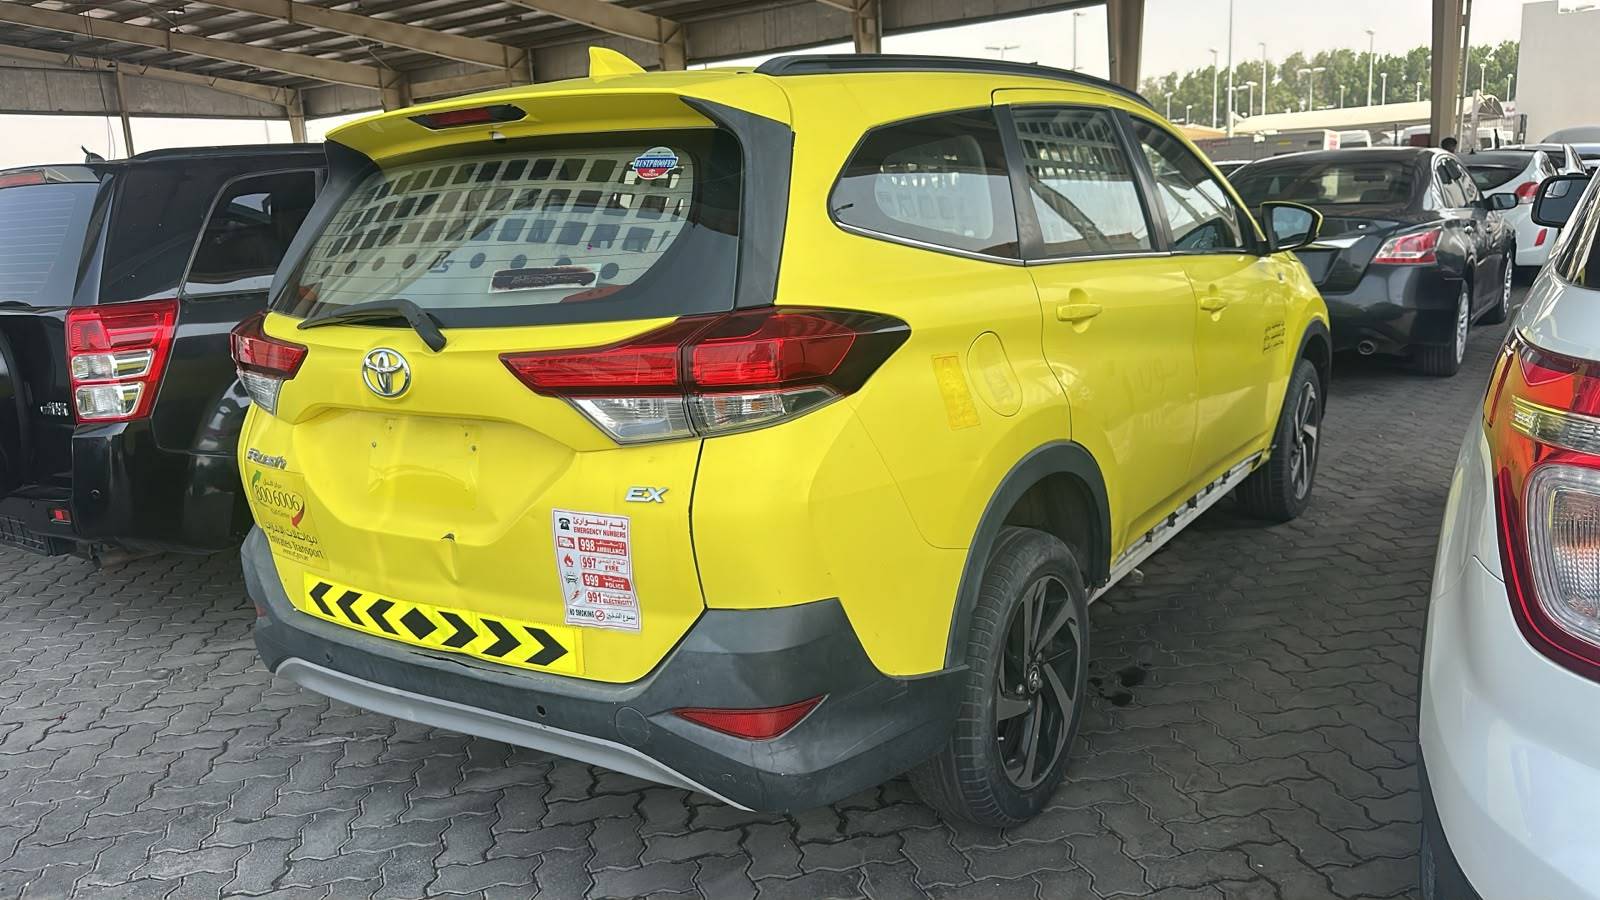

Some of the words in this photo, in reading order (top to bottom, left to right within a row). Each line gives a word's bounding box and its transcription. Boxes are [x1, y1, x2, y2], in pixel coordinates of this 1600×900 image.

[247, 447, 287, 470] Rush
[624, 486, 669, 503] EX
[573, 526, 602, 536] EMERGENCY
[602, 530, 626, 538] NUMBERS
[580, 538, 596, 552] 998
[596, 546, 625, 555] AMBULANCE
[582, 557, 597, 569] 997
[584, 574, 599, 587] 999
[605, 582, 625, 590] POLICE
[587, 591, 602, 604] 991
[603, 598, 632, 606] ELECTRICITY
[569, 608, 575, 616] NO
[575, 609, 594, 618] SMOKING
